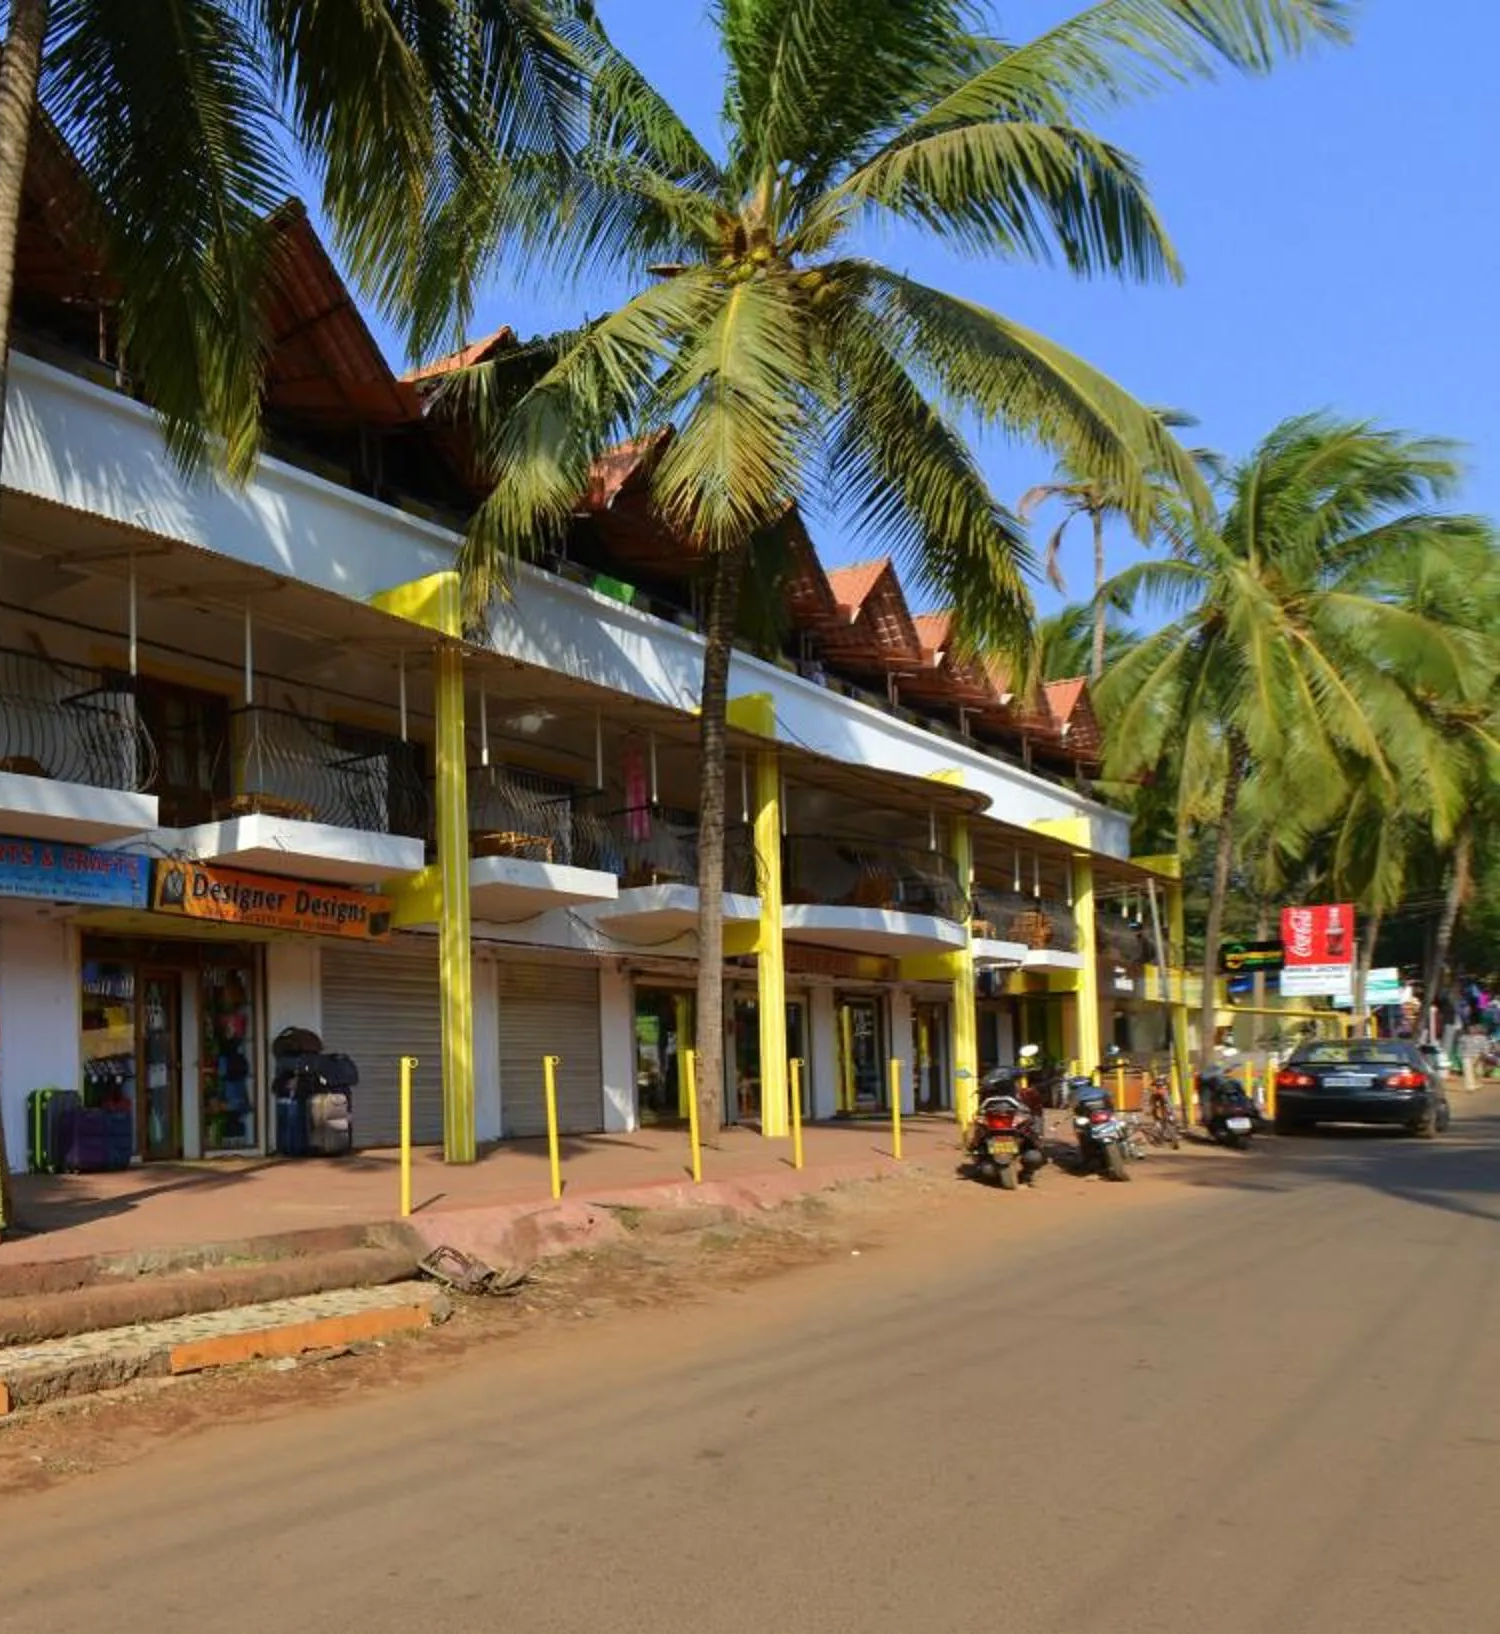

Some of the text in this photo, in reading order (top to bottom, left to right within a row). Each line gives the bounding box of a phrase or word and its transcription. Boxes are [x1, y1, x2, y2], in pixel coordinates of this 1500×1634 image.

[63, 850, 139, 878] CRAFTS
[193, 872, 287, 912] Designer
[294, 888, 368, 925] Designs
